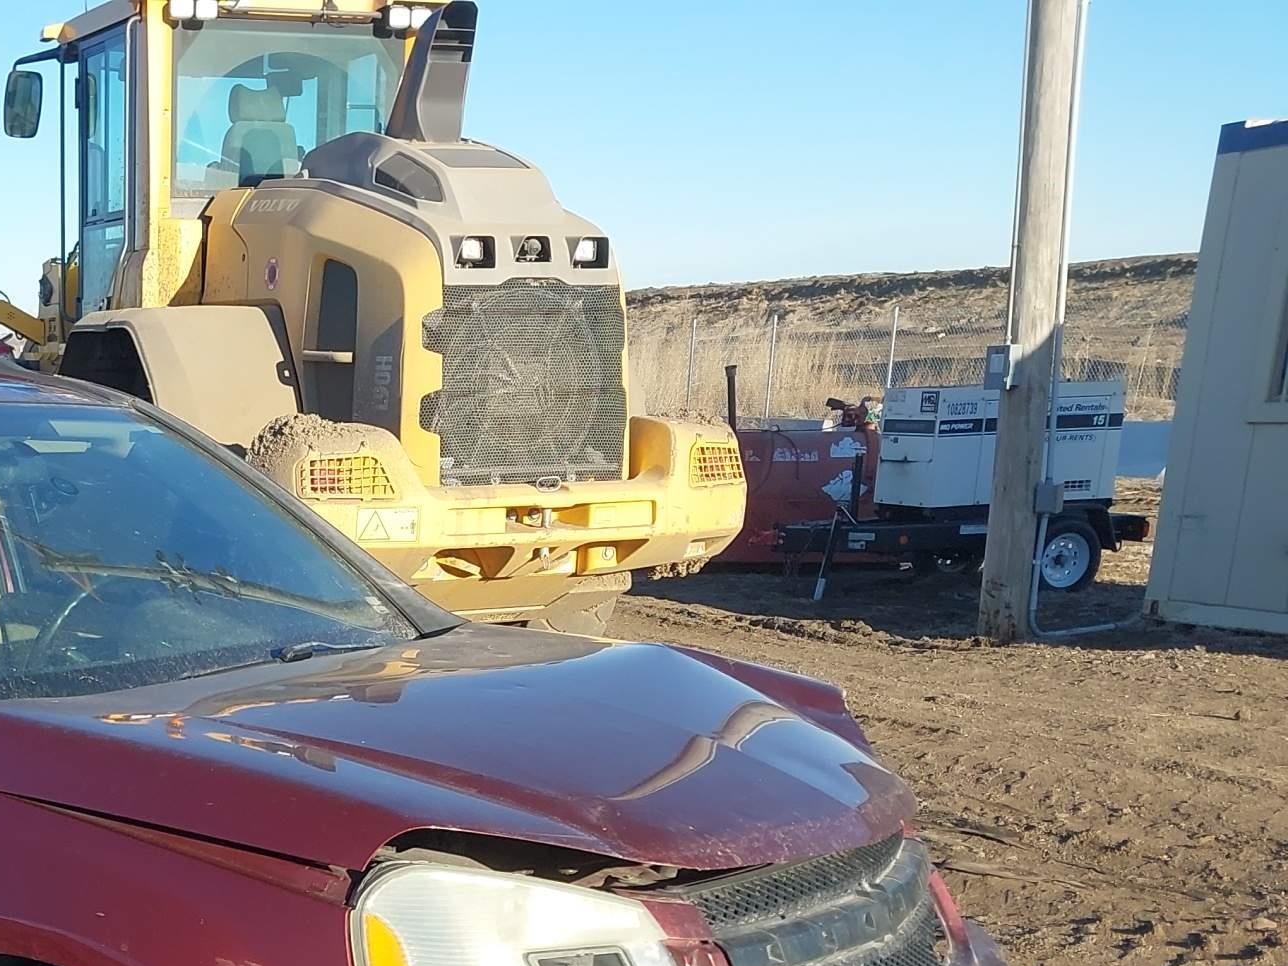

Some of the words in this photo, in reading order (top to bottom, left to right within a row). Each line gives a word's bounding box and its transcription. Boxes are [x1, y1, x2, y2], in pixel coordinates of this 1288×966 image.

[250, 199, 300, 213] VOLVO
[1075, 402, 1106, 412] Rentals
[1092, 415, 1105, 425] 15
